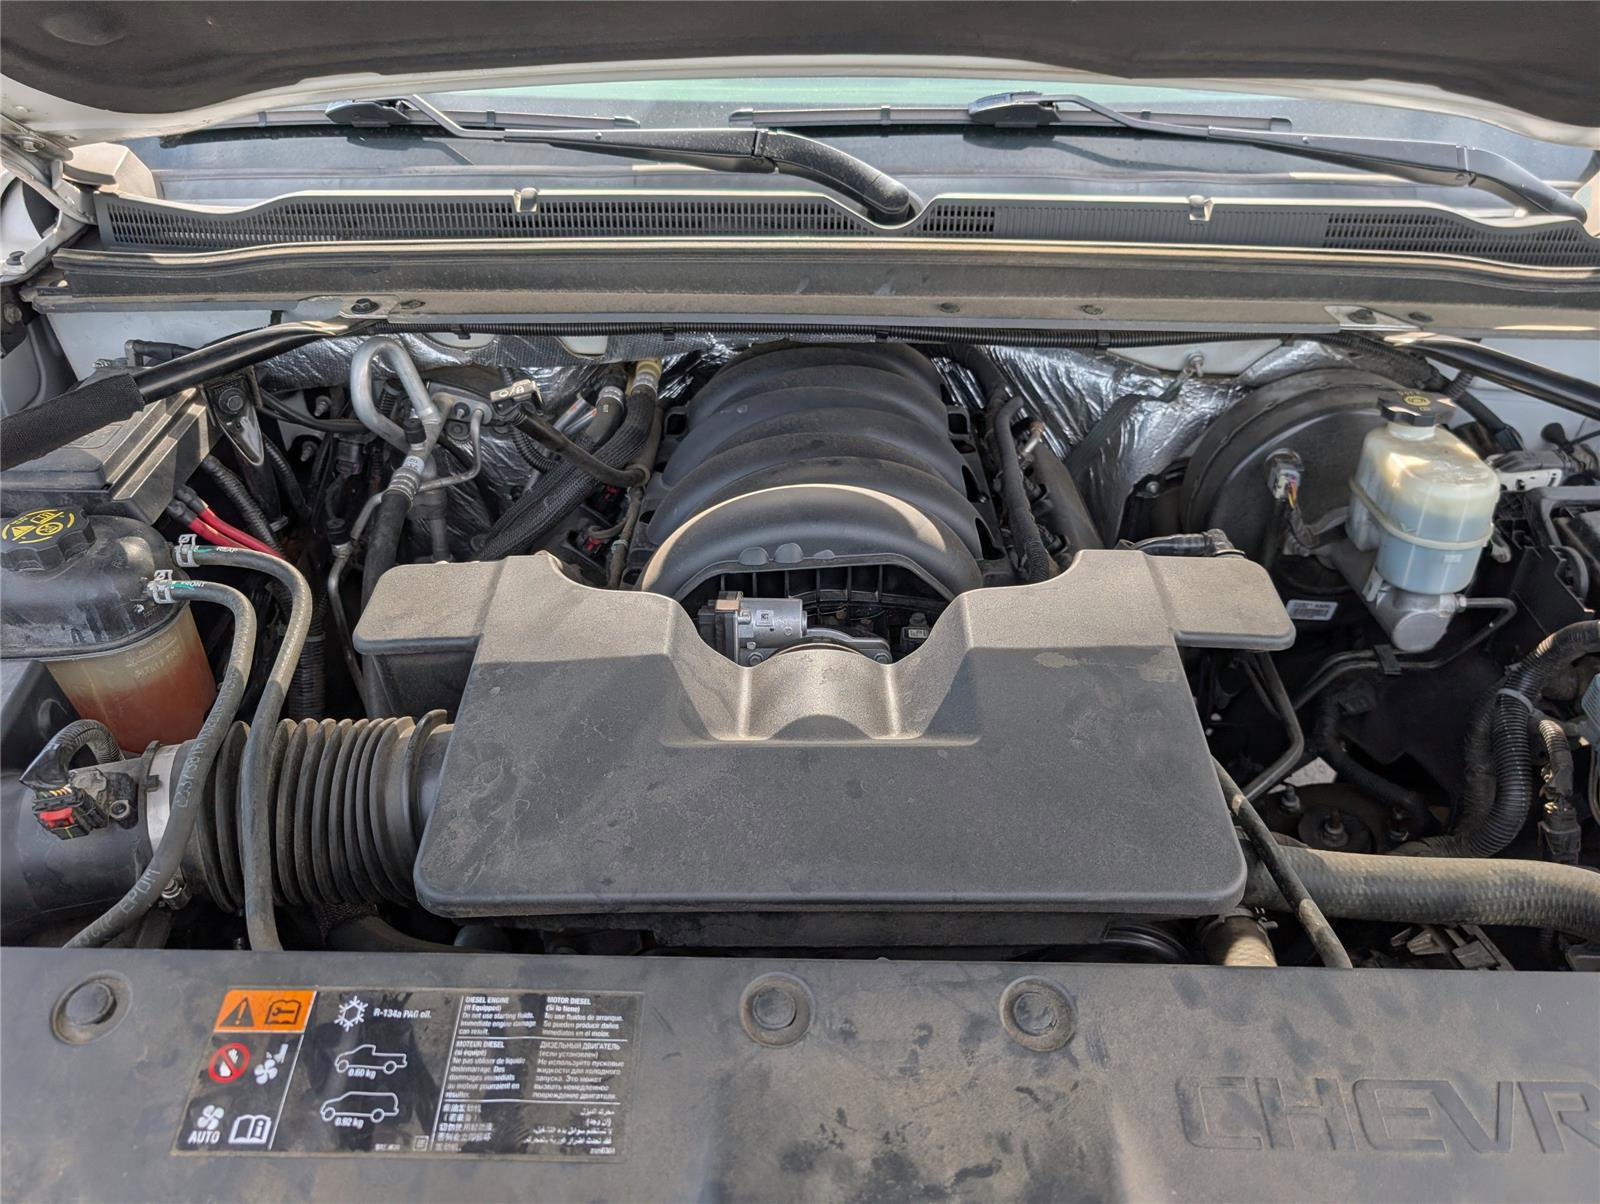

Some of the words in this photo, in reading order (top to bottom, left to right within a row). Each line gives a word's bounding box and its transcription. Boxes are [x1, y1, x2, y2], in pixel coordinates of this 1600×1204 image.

[120, 868, 161, 914] EPDM
[465, 996, 486, 1004] DIESEL
[487, 996, 509, 1004] ENGINE
[547, 996, 569, 1004] MOTOR
[570, 997, 591, 1006] DIESEL
[373, 1007, 402, 1018] R-134a
[455, 1040, 482, 1048] MOTEUR
[483, 1040, 504, 1049] DIESEL
[187, 1130, 221, 1144] AUTO
